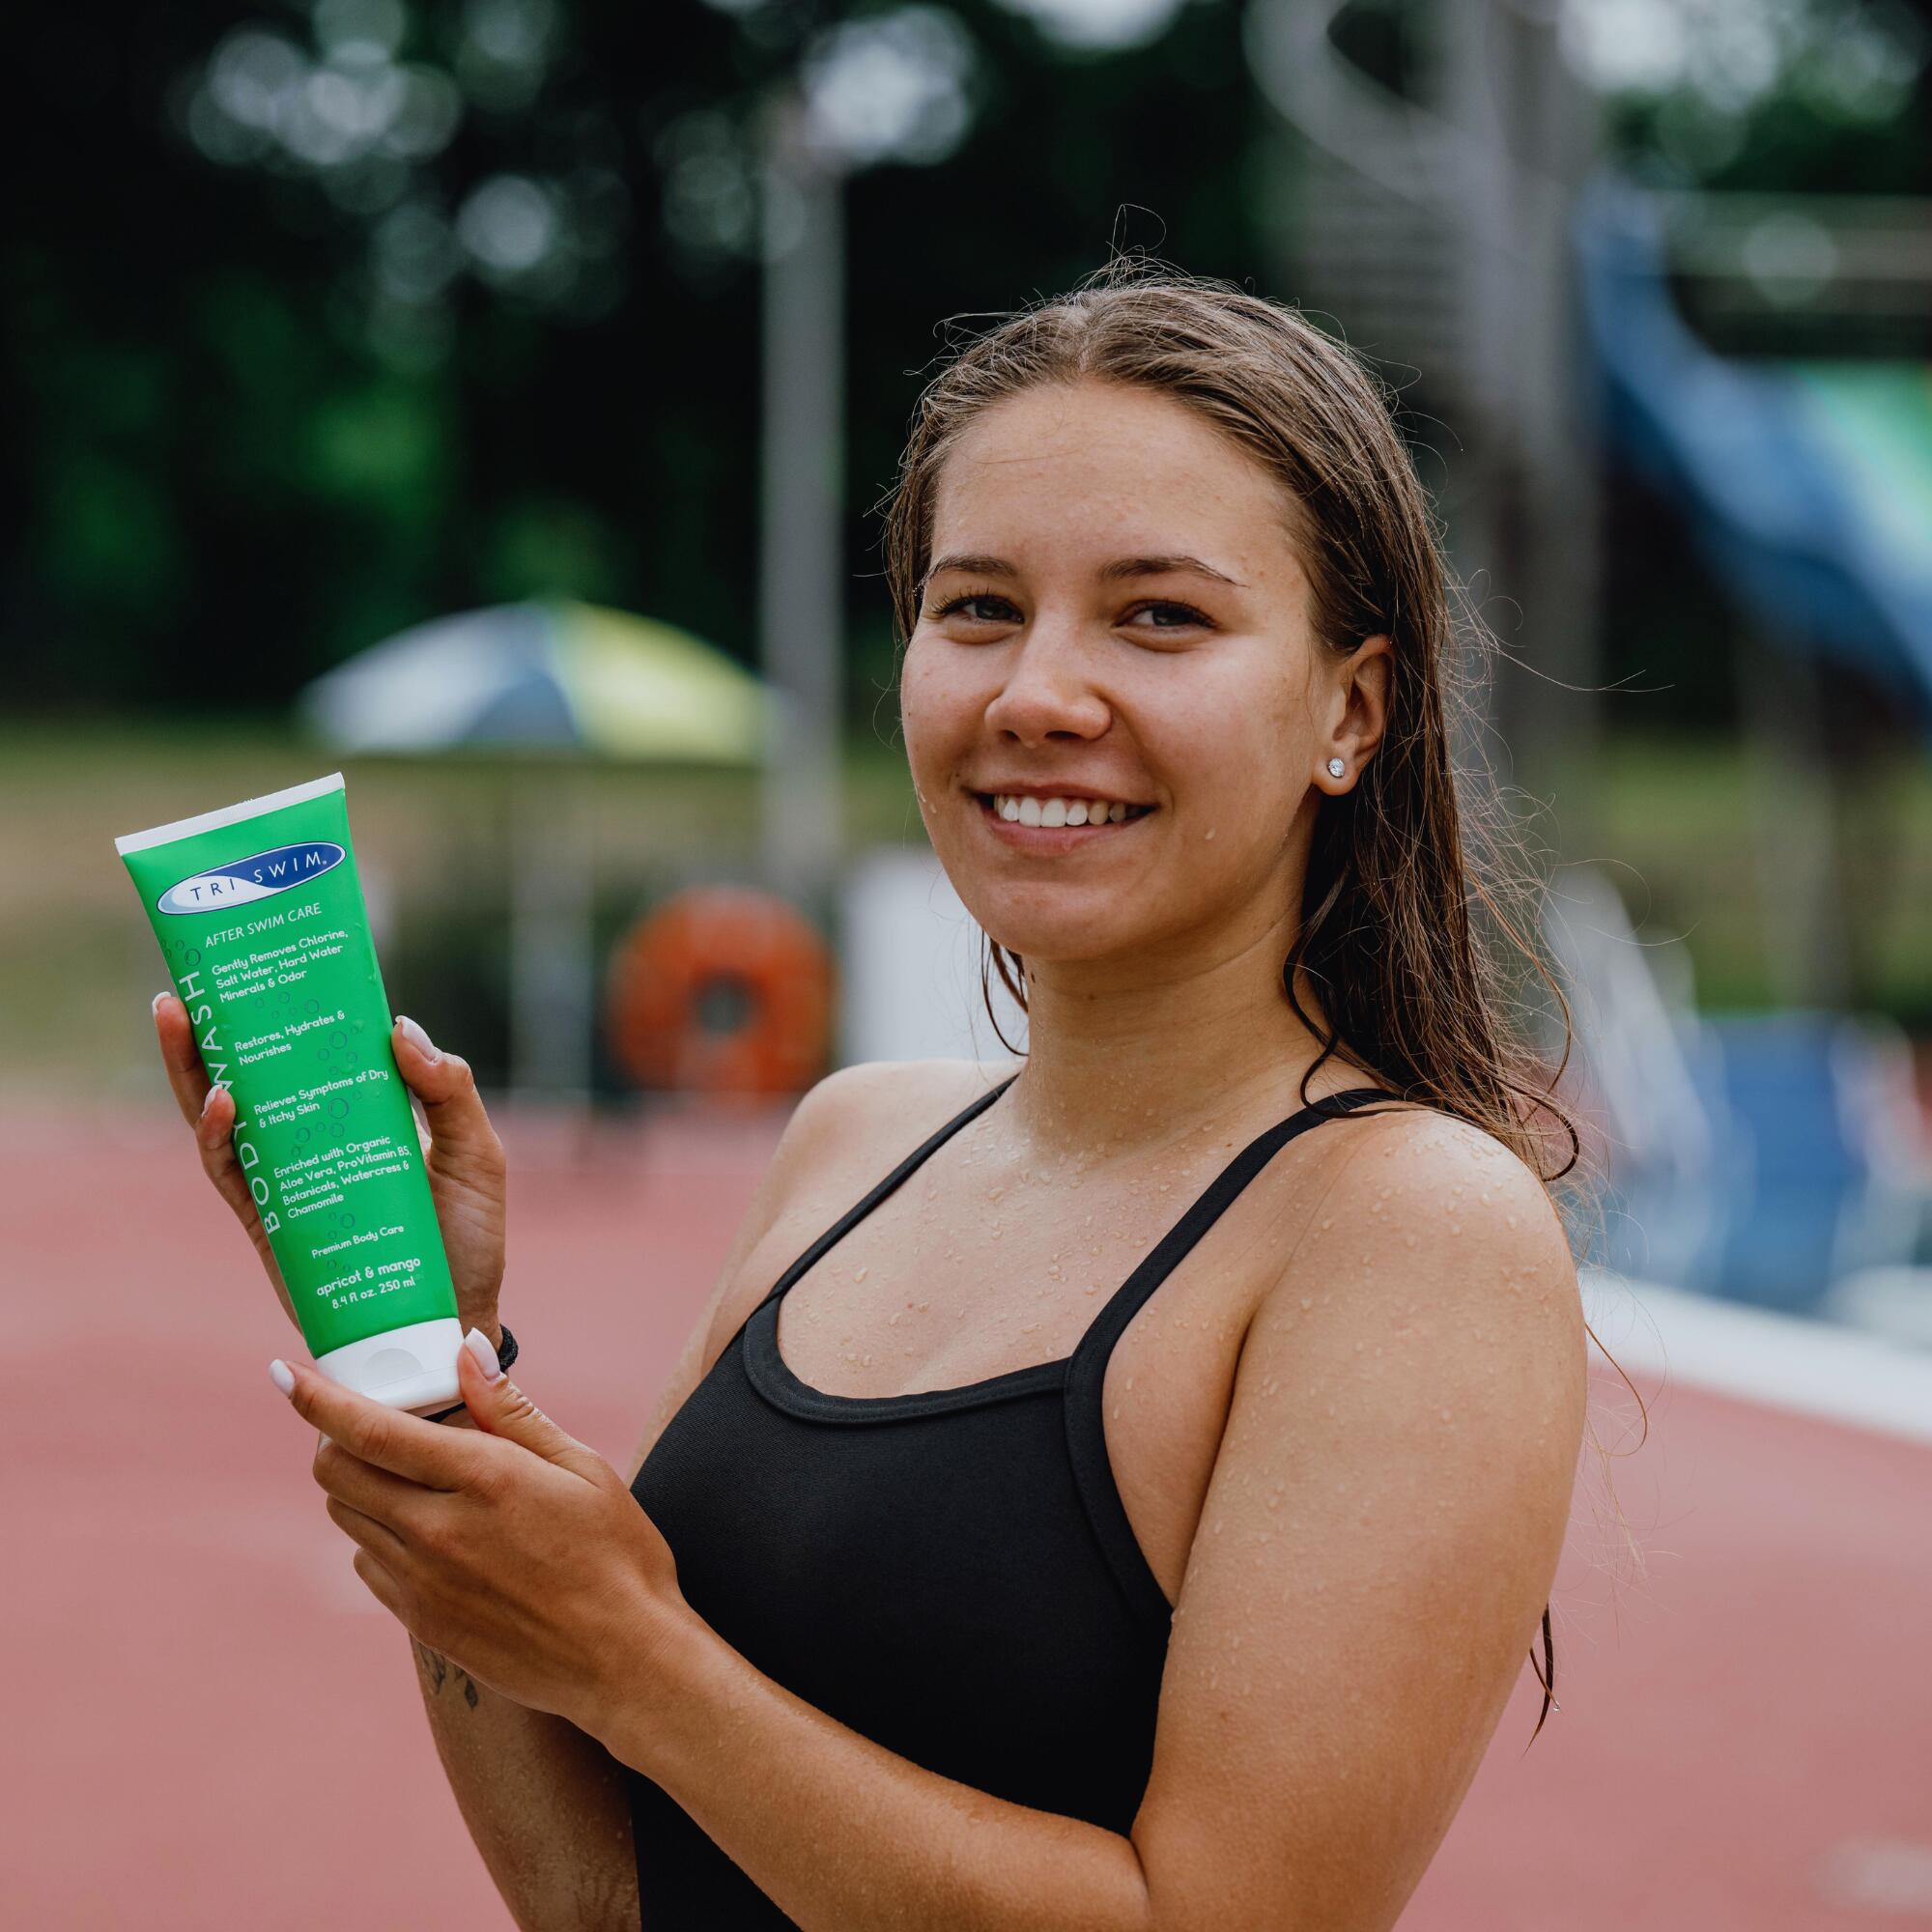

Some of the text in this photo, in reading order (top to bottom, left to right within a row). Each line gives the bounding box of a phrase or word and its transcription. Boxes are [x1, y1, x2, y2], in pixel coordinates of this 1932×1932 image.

[189, 878, 235, 901] TRI
[205, 902, 322, 949] AFTER SWIM CARE
[212, 929, 349, 976] Gently Removes Chlorine,
[216, 974, 239, 989] Salt
[278, 953, 307, 970] Hard
[309, 945, 343, 960] Water
[219, 970, 307, 1003] Minerals & Odor
[235, 1010, 345, 1052] Restores, Hydrates &
[239, 1043, 292, 1065] Nourishes
[254, 1069, 389, 1115] Relieves Symptoms of Dry
[259, 1101, 321, 1128] & Itchy Skin
[273, 1135, 391, 1179] Enriched with Organic
[279, 1145, 412, 1192] Aloe Vera, ProVitamin B5,
[282, 1160, 410, 1206] Botanicals, Watercress &
[287, 1193, 345, 1219] Chamomile
[311, 1225, 405, 1259] Premium Body Care
[316, 1258, 421, 1297] apricot & mango
[331, 1276, 416, 1309] 8.4 fl oz. 250 ml
